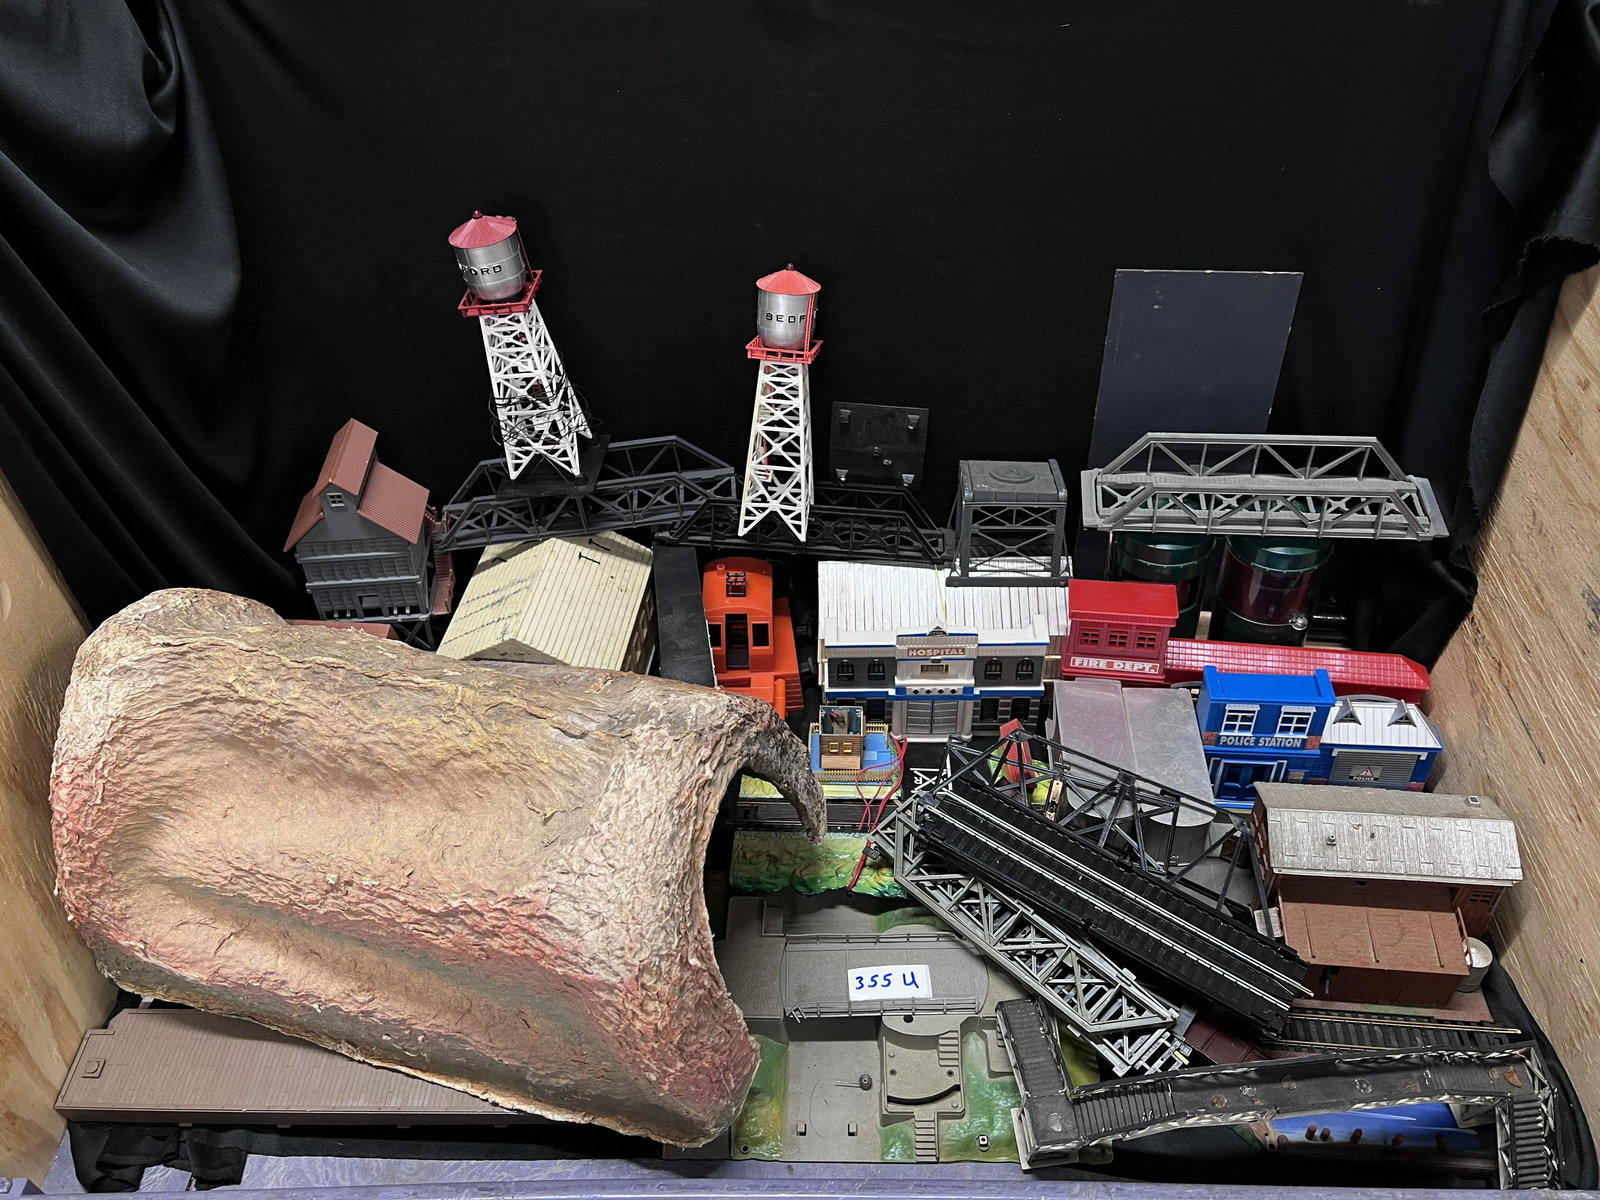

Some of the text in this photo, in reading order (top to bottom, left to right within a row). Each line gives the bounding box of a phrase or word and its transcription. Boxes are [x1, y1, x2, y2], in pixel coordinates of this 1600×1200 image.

[1074, 657, 1156, 672] FIRE DEPT.
[1220, 736, 1302, 748] POLICE STATION
[855, 973, 893, 990] 355
